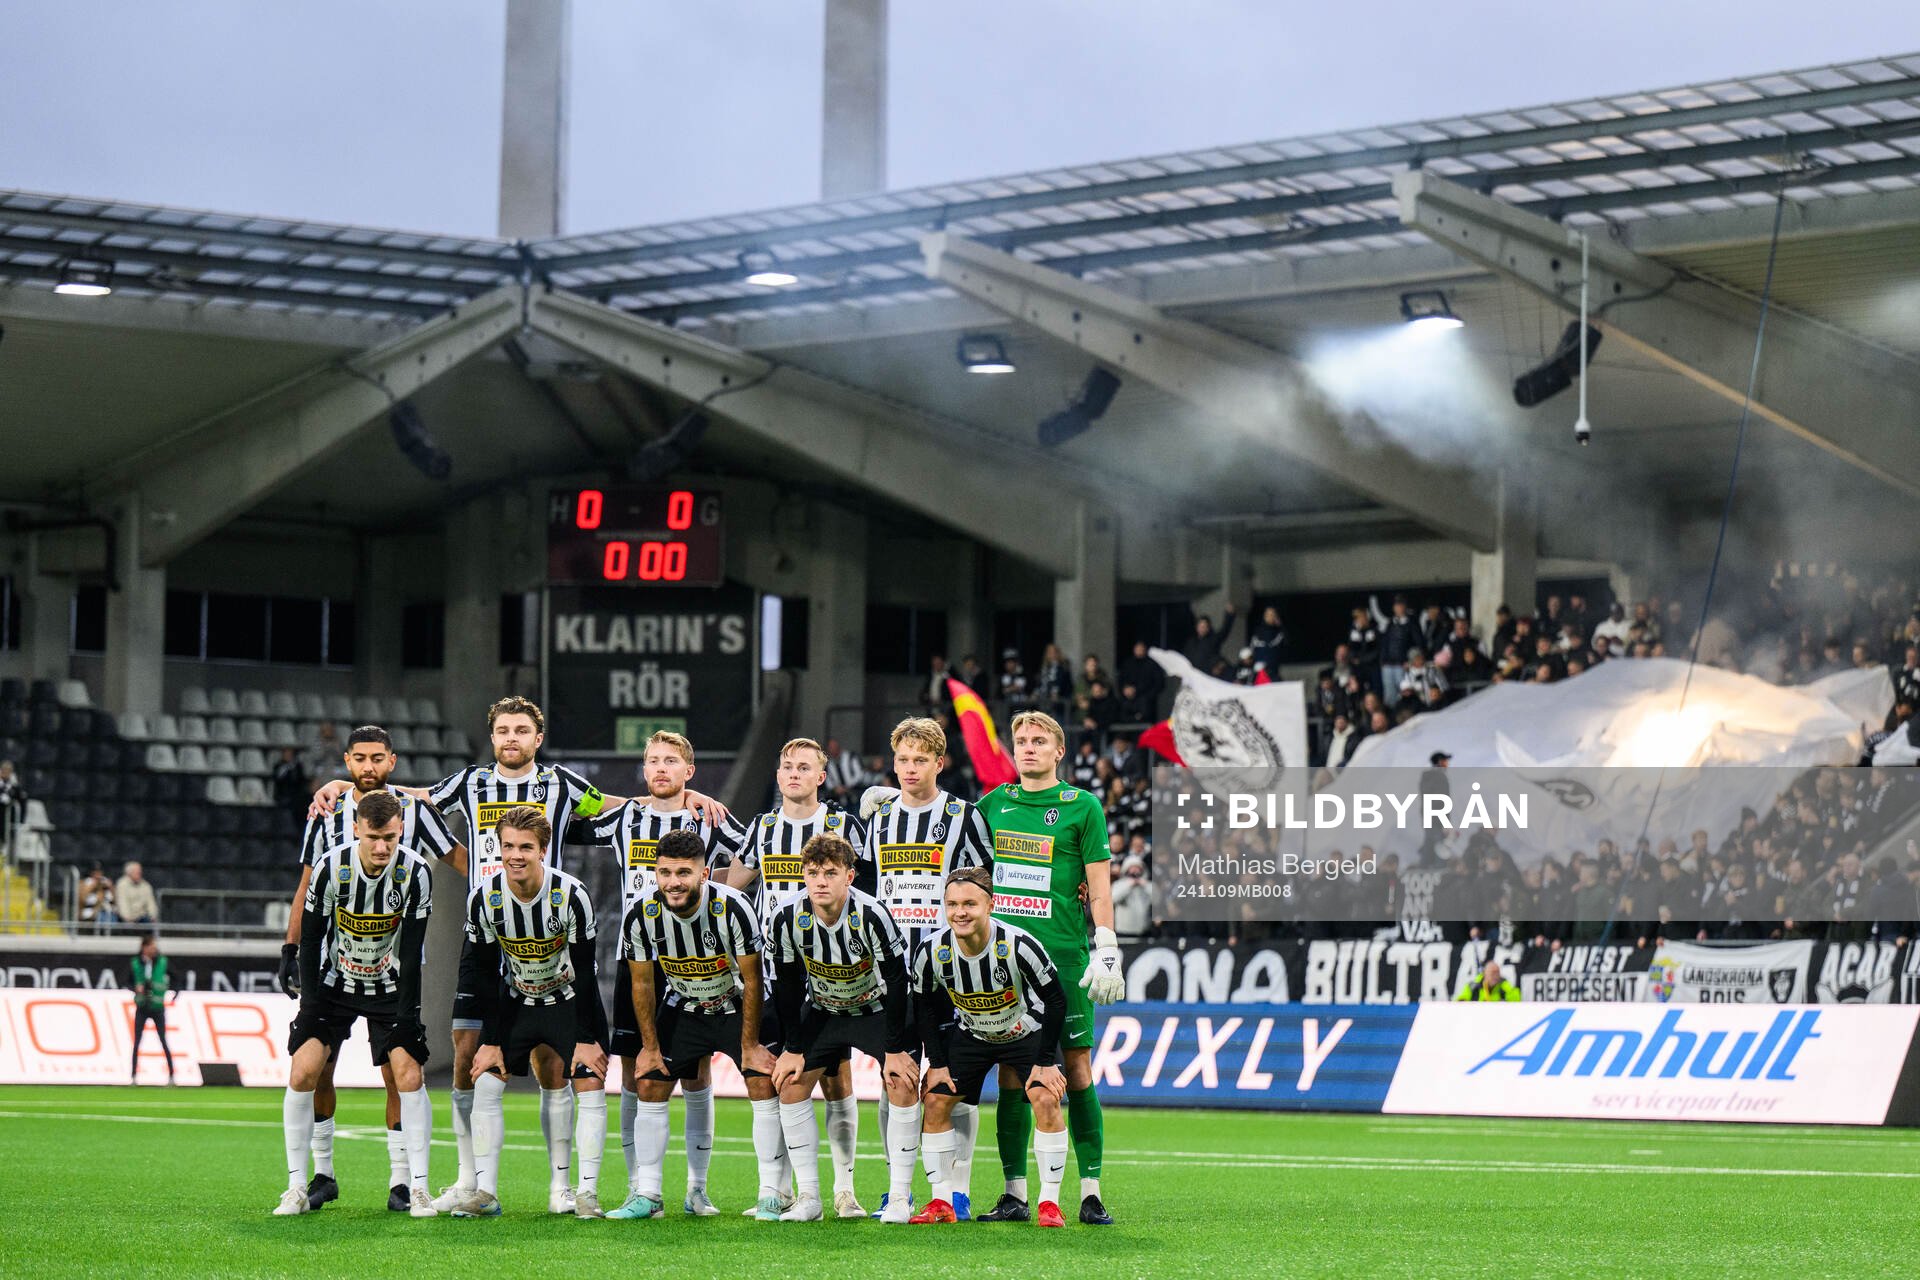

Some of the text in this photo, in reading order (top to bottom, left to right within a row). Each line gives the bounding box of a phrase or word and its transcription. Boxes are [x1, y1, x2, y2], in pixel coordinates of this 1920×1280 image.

[576, 490, 603, 529] 0
[667, 491, 694, 530] 0
[609, 661, 690, 708] RÖR
[882, 851, 930, 864] OHLSSONS
[340, 913, 392, 931] OHLSSONS
[664, 962, 717, 974] OHLSSONS
[1820, 941, 1898, 996] ACAB
[1466, 1008, 1822, 1081] Amhult
